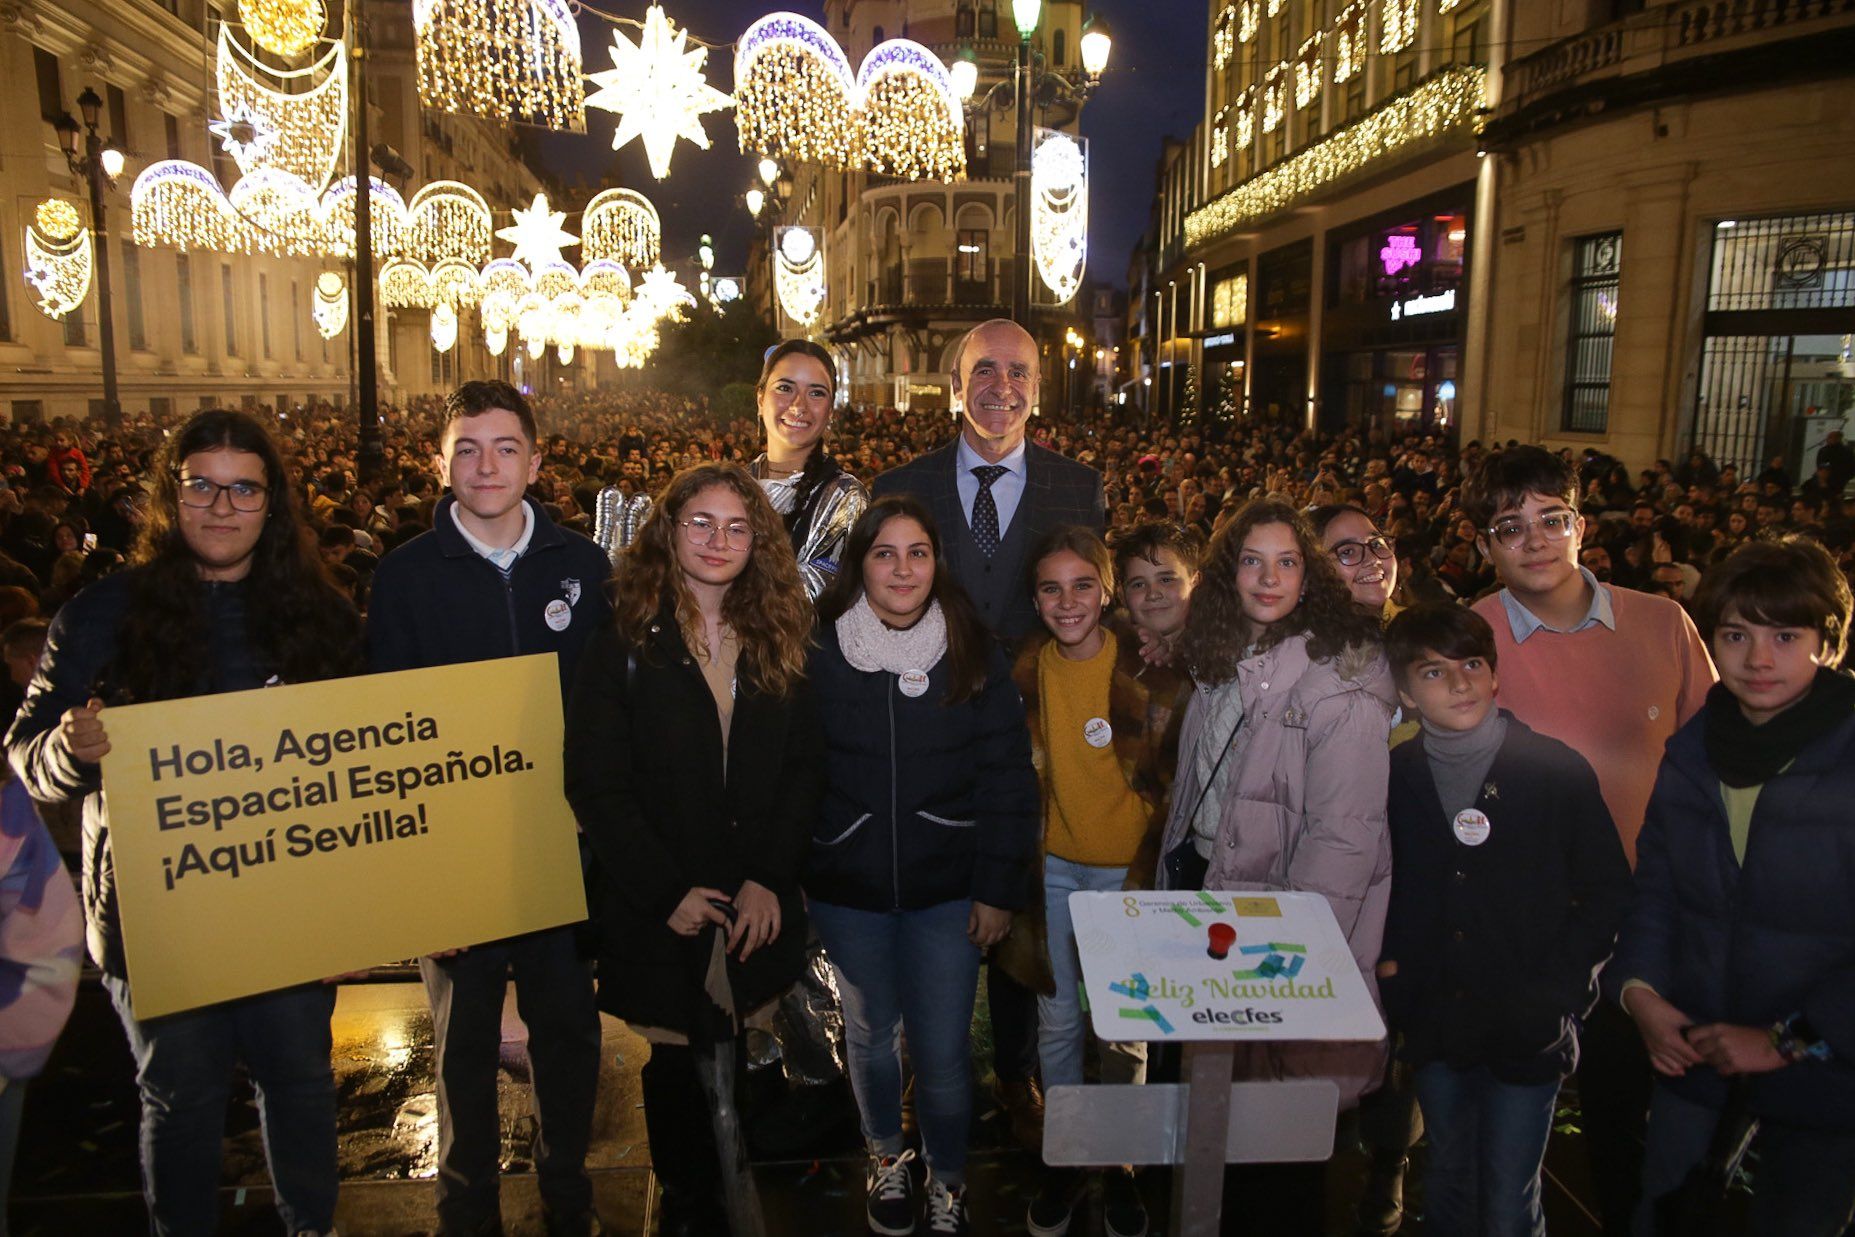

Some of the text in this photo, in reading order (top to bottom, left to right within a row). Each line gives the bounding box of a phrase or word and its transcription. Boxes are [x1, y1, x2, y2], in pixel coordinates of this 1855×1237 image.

[149, 711, 440, 782] Hola, Agencia
[155, 745, 535, 832] Espacial Española.
[161, 803, 430, 891] ¡Aquí Sevilla!
[1202, 975, 1338, 1000] Navidad
